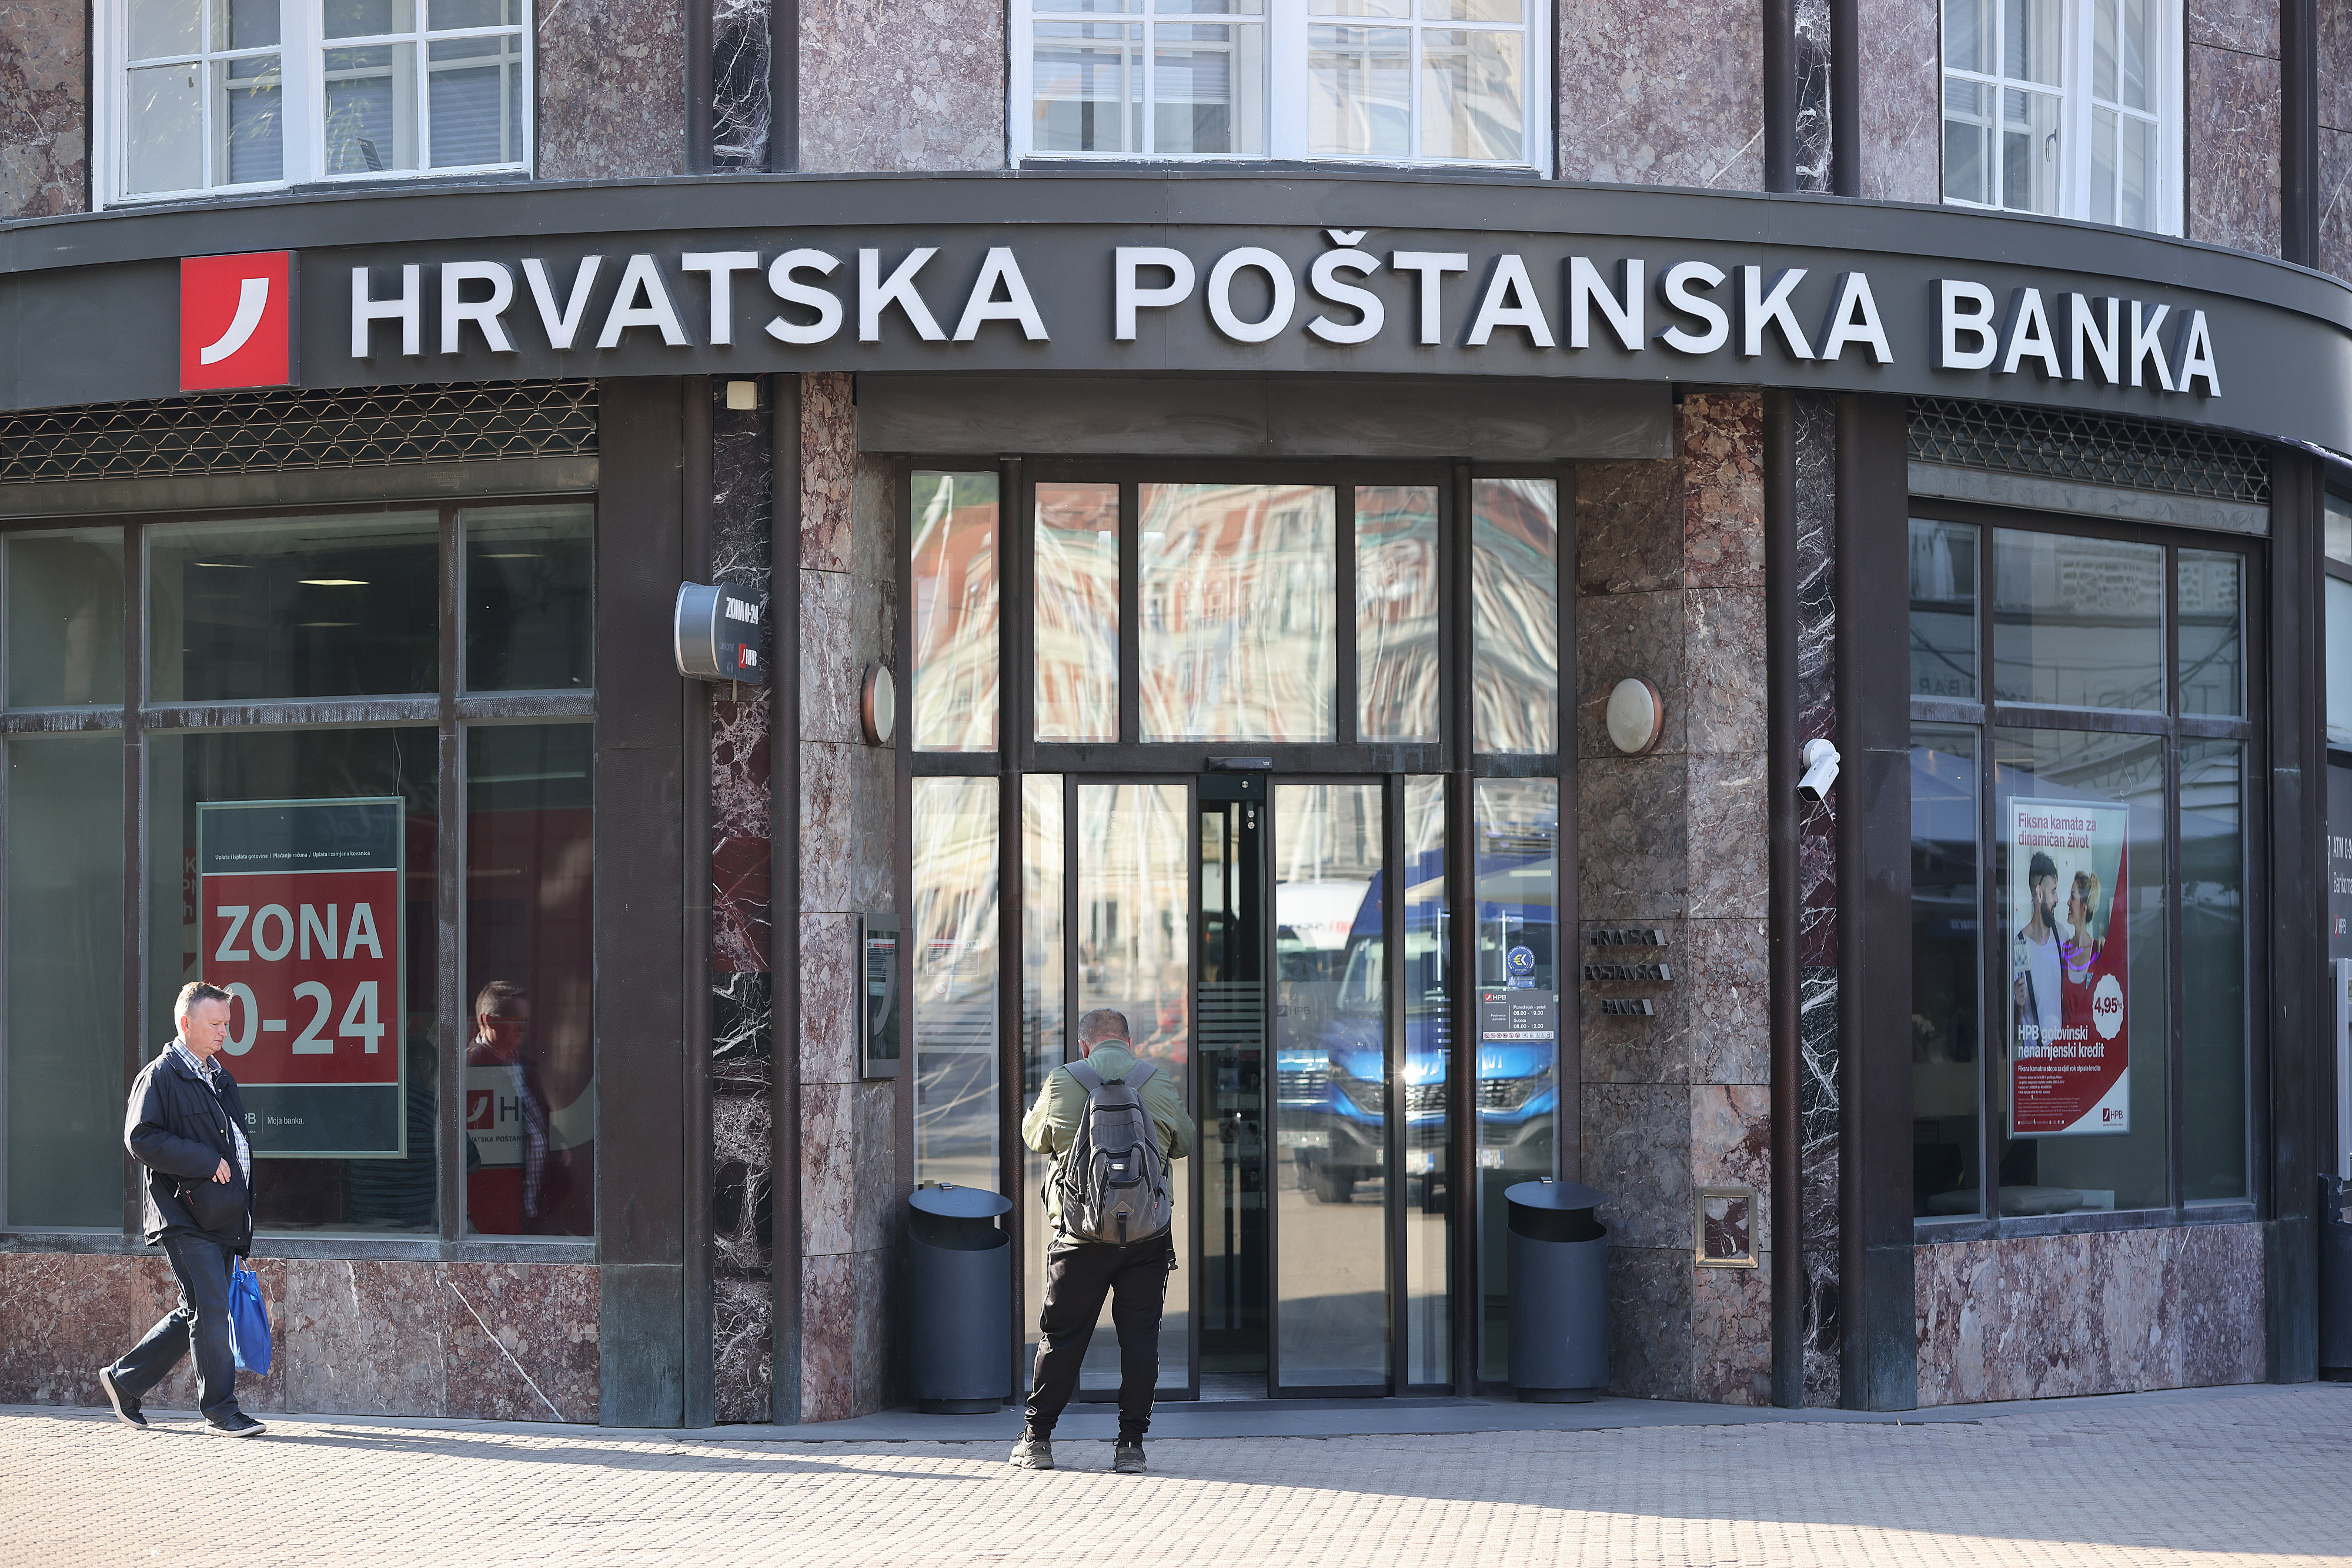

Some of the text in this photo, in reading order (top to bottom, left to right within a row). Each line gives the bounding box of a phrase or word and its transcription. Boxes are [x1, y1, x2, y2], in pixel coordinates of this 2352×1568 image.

[352, 228, 2221, 397] HRVATSKA POŠTANSKA BANKA
[726, 597, 759, 625] ZONA 0-24
[746, 648, 757, 666] HPB
[2019, 813, 2096, 831] Fiksna kamata za
[2019, 830, 2089, 848] dinamičan život
[2333, 836, 2344, 858] ATM
[215, 902, 383, 962] ZONA
[1590, 930, 1668, 946] HRVATSKA
[1289, 1007, 1311, 1015] HPB
[1602, 999, 1655, 1015] BANKA
[221, 981, 385, 1056] 0-24
[2018, 1024, 2088, 1044] HPB gotovinski
[2018, 1042, 2104, 1061] nenamjenski kredit
[267, 1116, 305, 1126] Moja banka.
[2111, 1110, 2123, 1119] HPB
